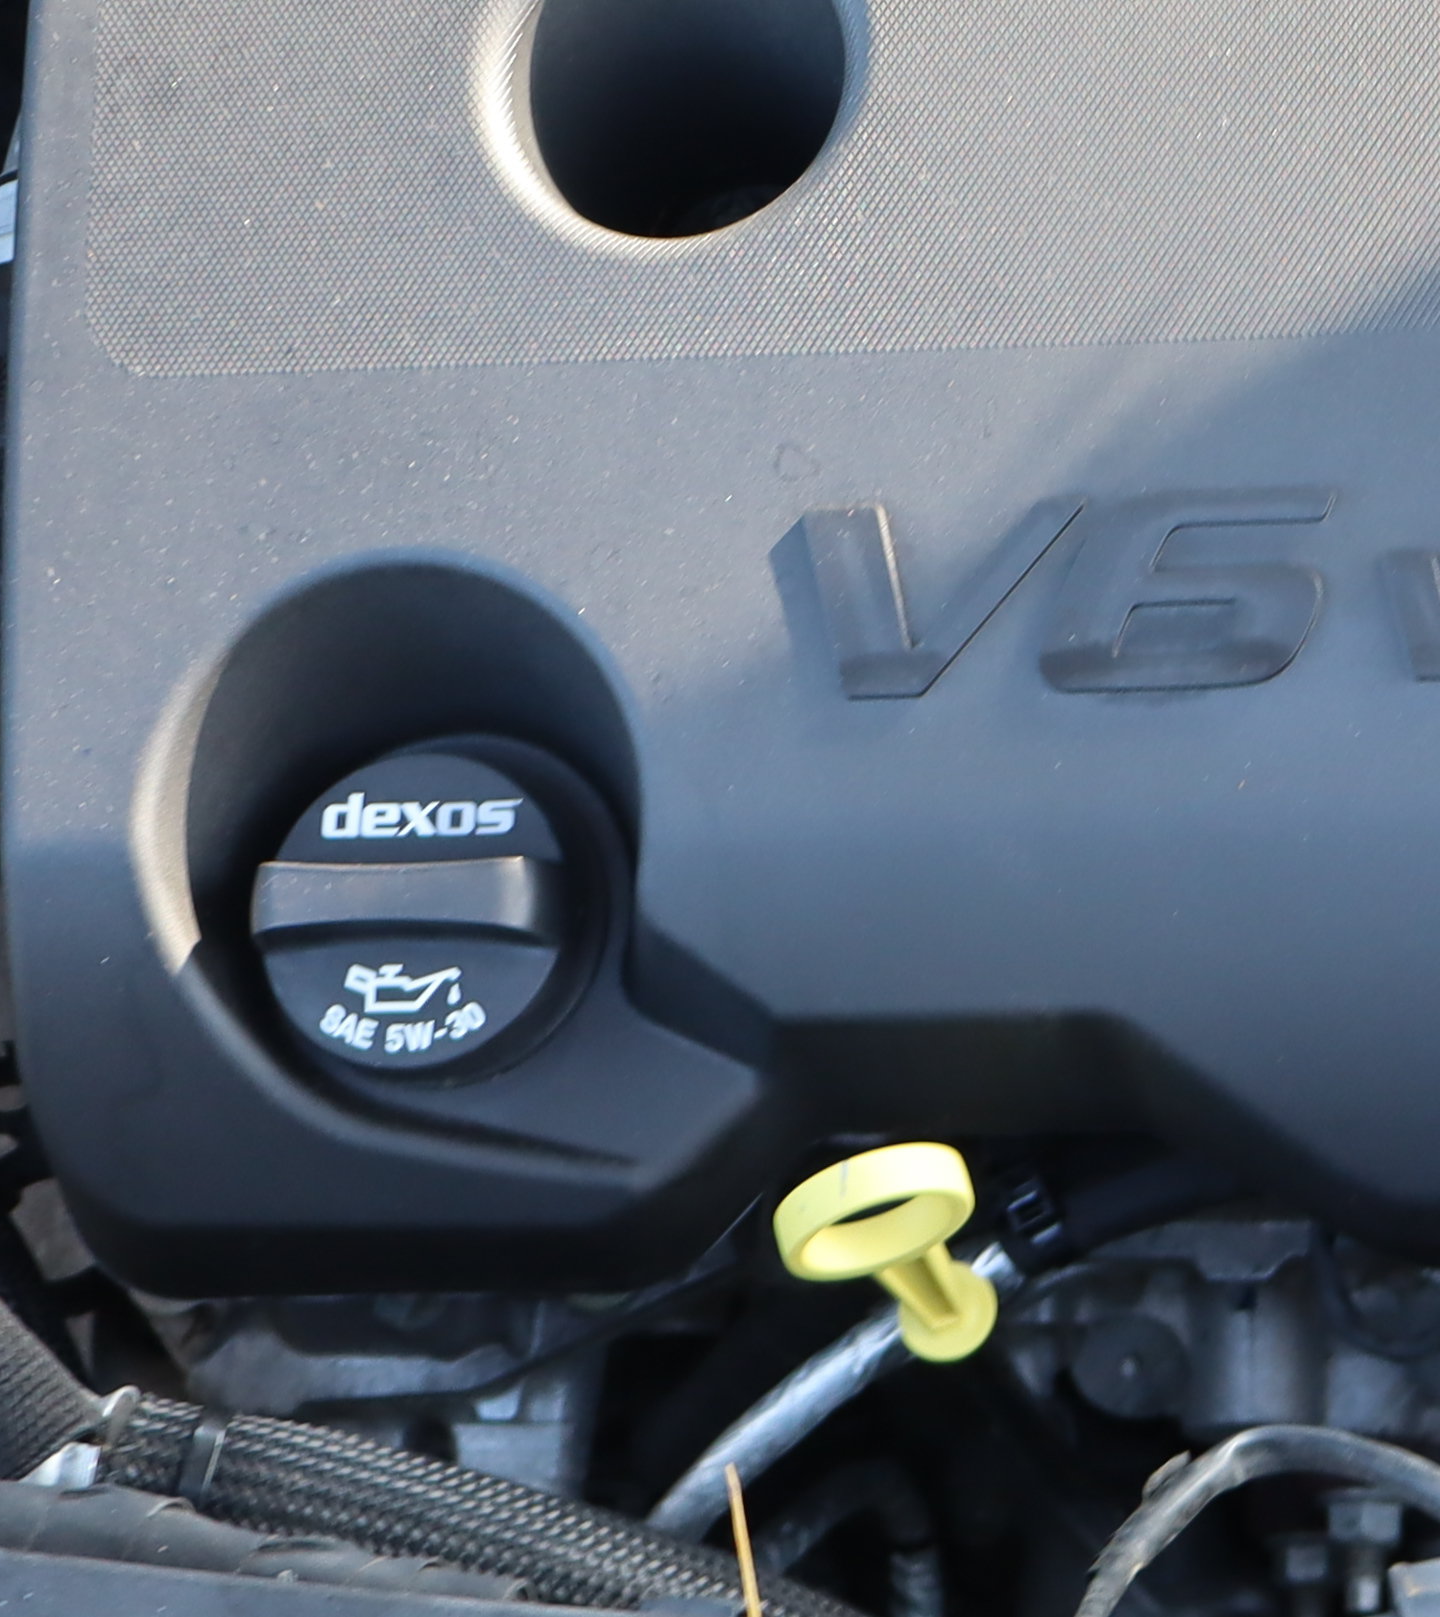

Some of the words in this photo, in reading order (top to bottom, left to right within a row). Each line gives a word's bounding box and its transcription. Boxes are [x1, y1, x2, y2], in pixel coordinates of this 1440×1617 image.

[775, 488, 1339, 701] V6
[321, 792, 524, 839] dexos
[319, 1003, 379, 1050] SAE
[384, 1000, 487, 1054] 5W-30
